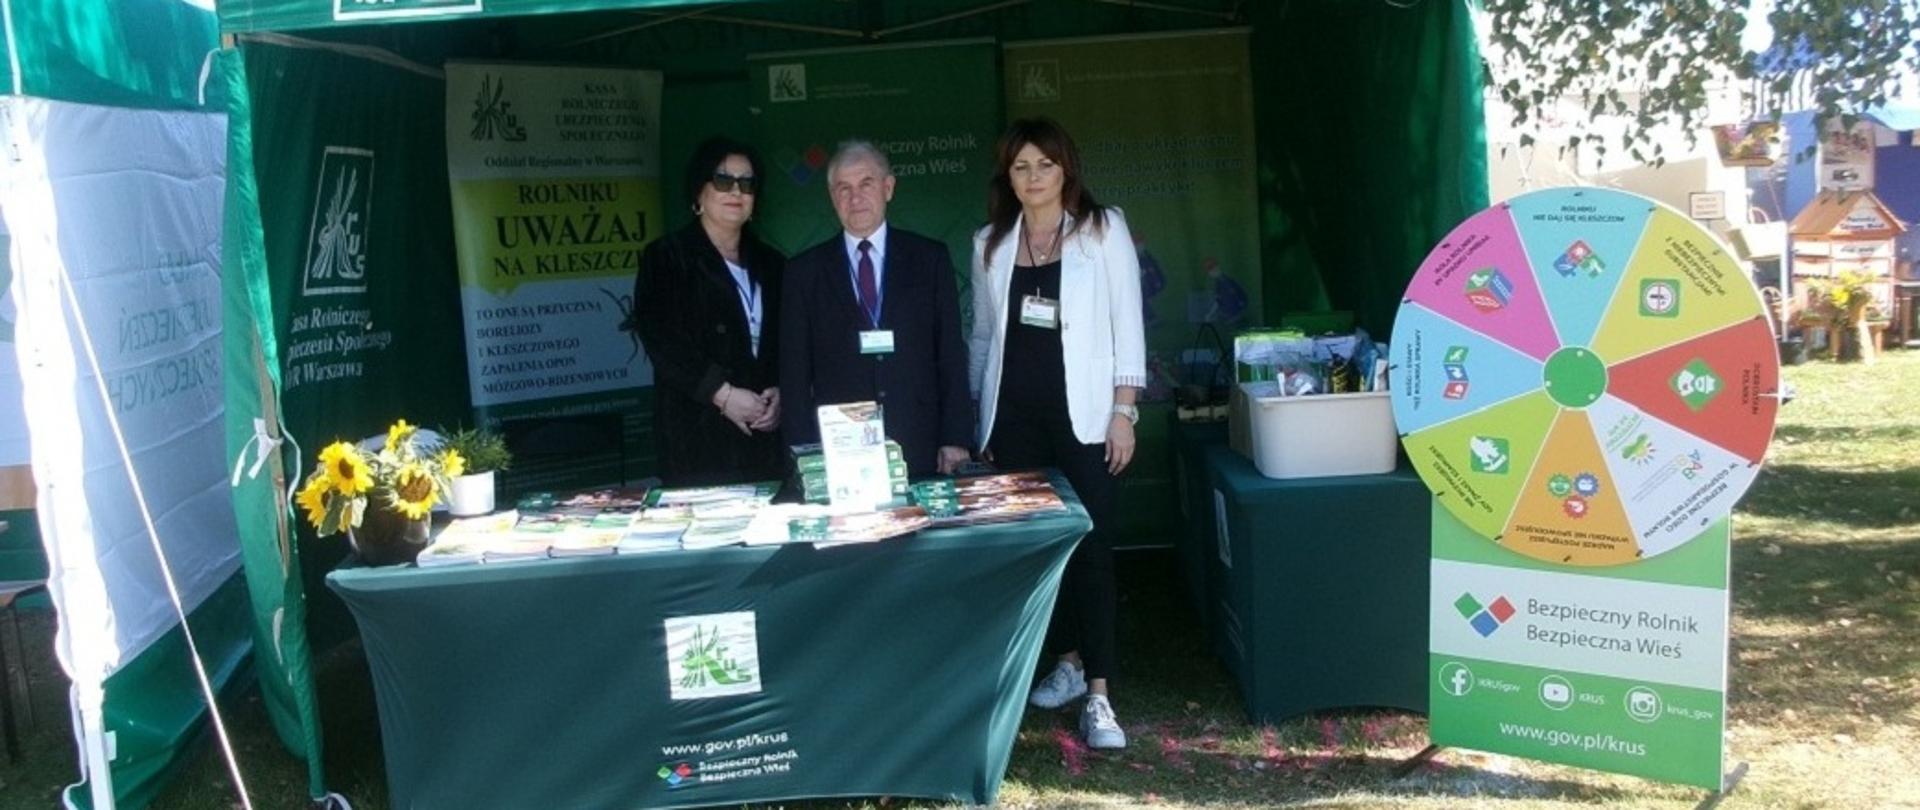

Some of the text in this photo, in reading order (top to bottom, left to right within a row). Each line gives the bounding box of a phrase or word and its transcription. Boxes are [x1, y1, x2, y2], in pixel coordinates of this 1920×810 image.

[584, 83, 617, 95] KASA
[928, 134, 977, 153] Rolnik
[928, 158, 967, 174] Wieś
[519, 183, 618, 204] ROLNIKU
[496, 204, 647, 249] UWAŻAJ
[494, 257, 525, 277] NA
[1683, 239, 1723, 278] BEZPIECZNIE
[475, 309, 493, 321] TO
[495, 307, 519, 319] ONE
[537, 301, 602, 315] PRZYCZYNĄ
[477, 323, 542, 339] BORELIOZY
[487, 338, 580, 357] KLESZCZOWEGO
[481, 356, 577, 377] ZAPALENIA OPON
[482, 367, 628, 393] MÓZGOWO-RDZENIOWYCH
[1687, 482, 1728, 516] BEZPIECZNE
[1527, 598, 1699, 634] Bezpieczny Rolnik
[1526, 624, 1682, 659] Bezpieczna Wieś
[661, 732, 790, 756] www.gov.pl/krus
[1499, 720, 1647, 757] www.gov.pl/krus
[698, 749, 799, 772] Bezpieczny Rolnik
[698, 761, 791, 783] Bezpieczna Wieś
